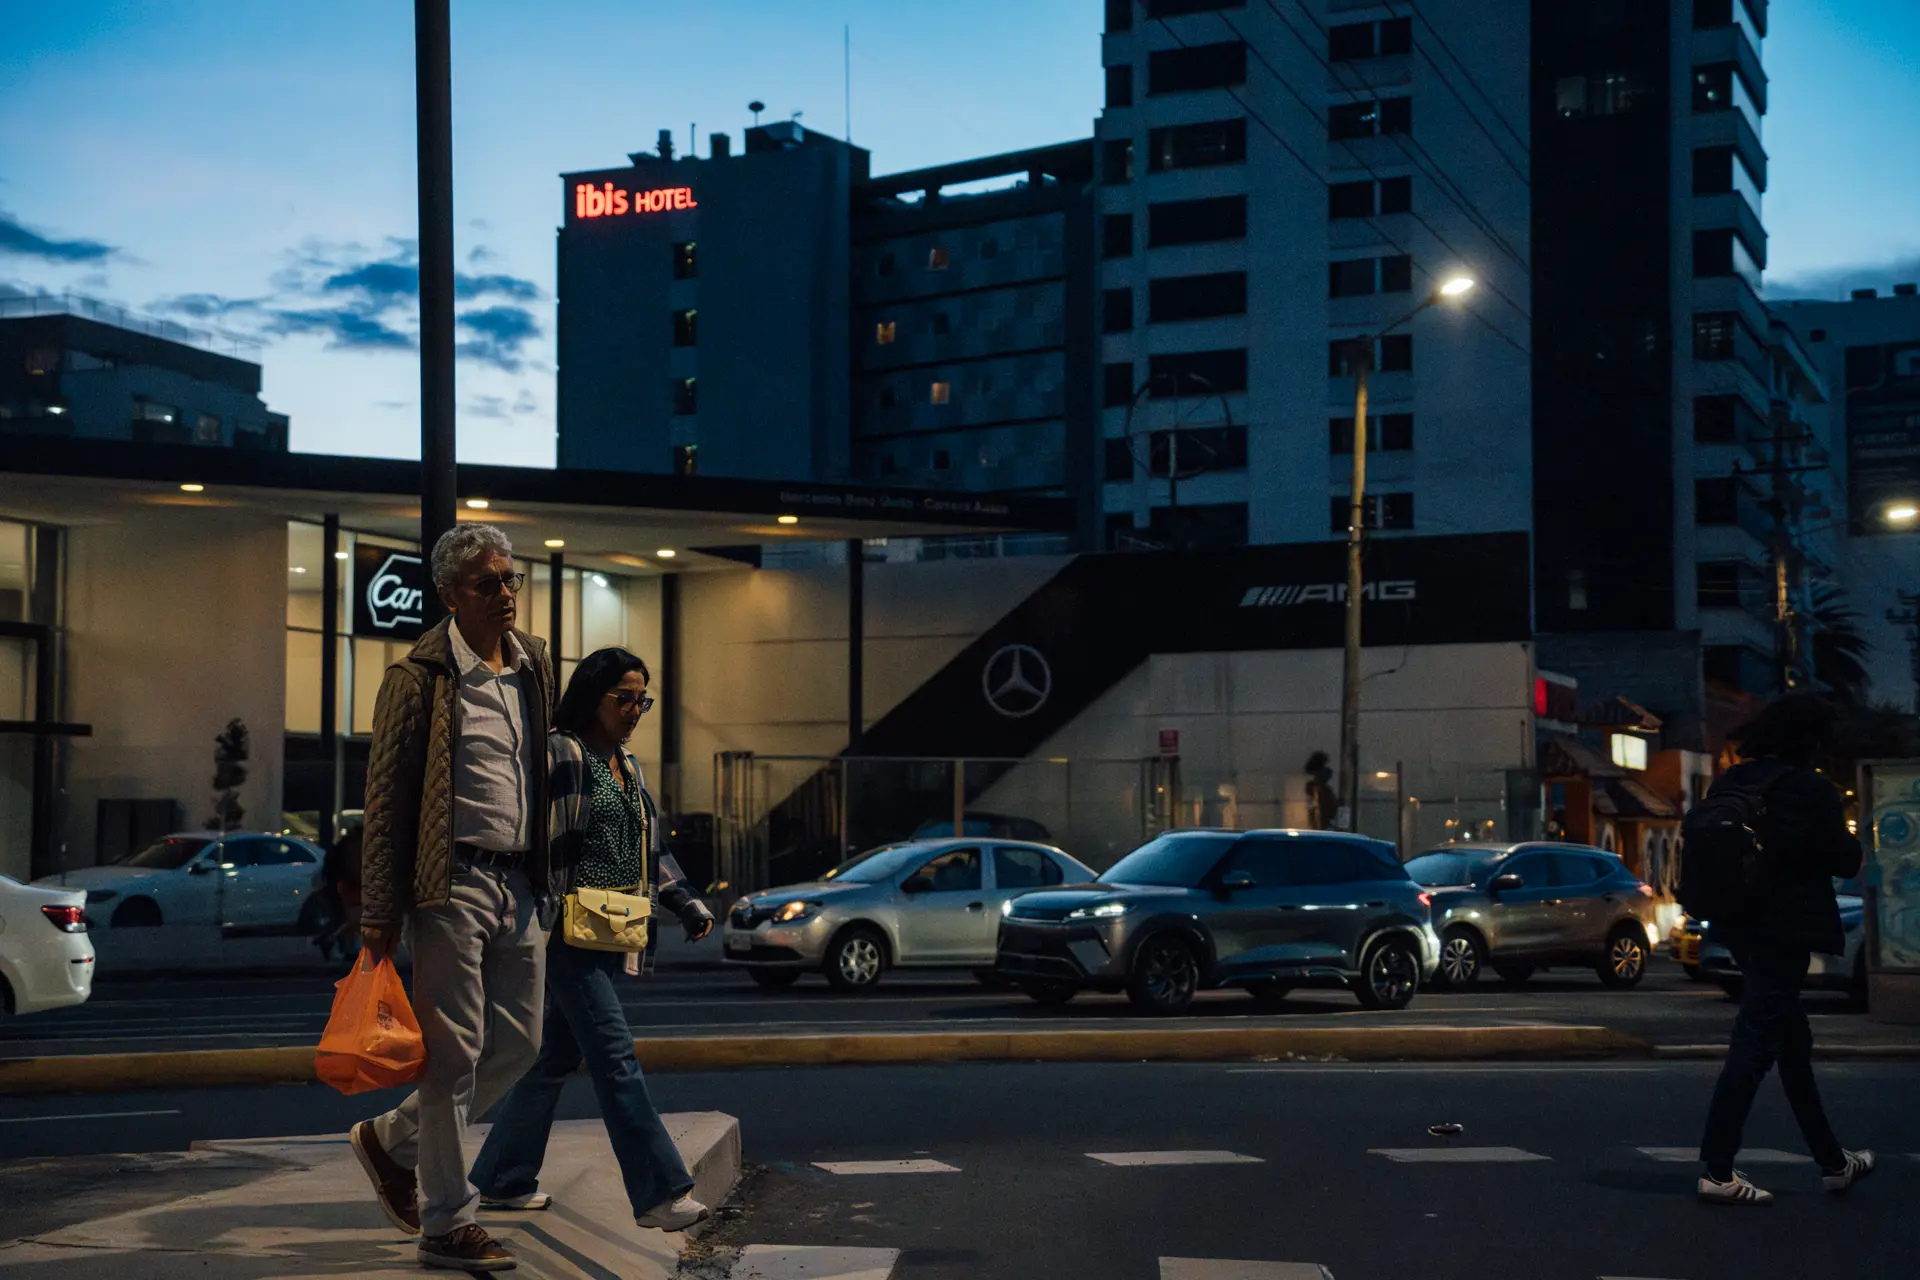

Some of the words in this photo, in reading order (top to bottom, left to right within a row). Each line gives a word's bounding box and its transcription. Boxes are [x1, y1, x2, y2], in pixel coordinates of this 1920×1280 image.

[576, 182, 629, 218] ibis
[635, 187, 697, 213] HOTEL
[1297, 580, 1416, 604] AMG
